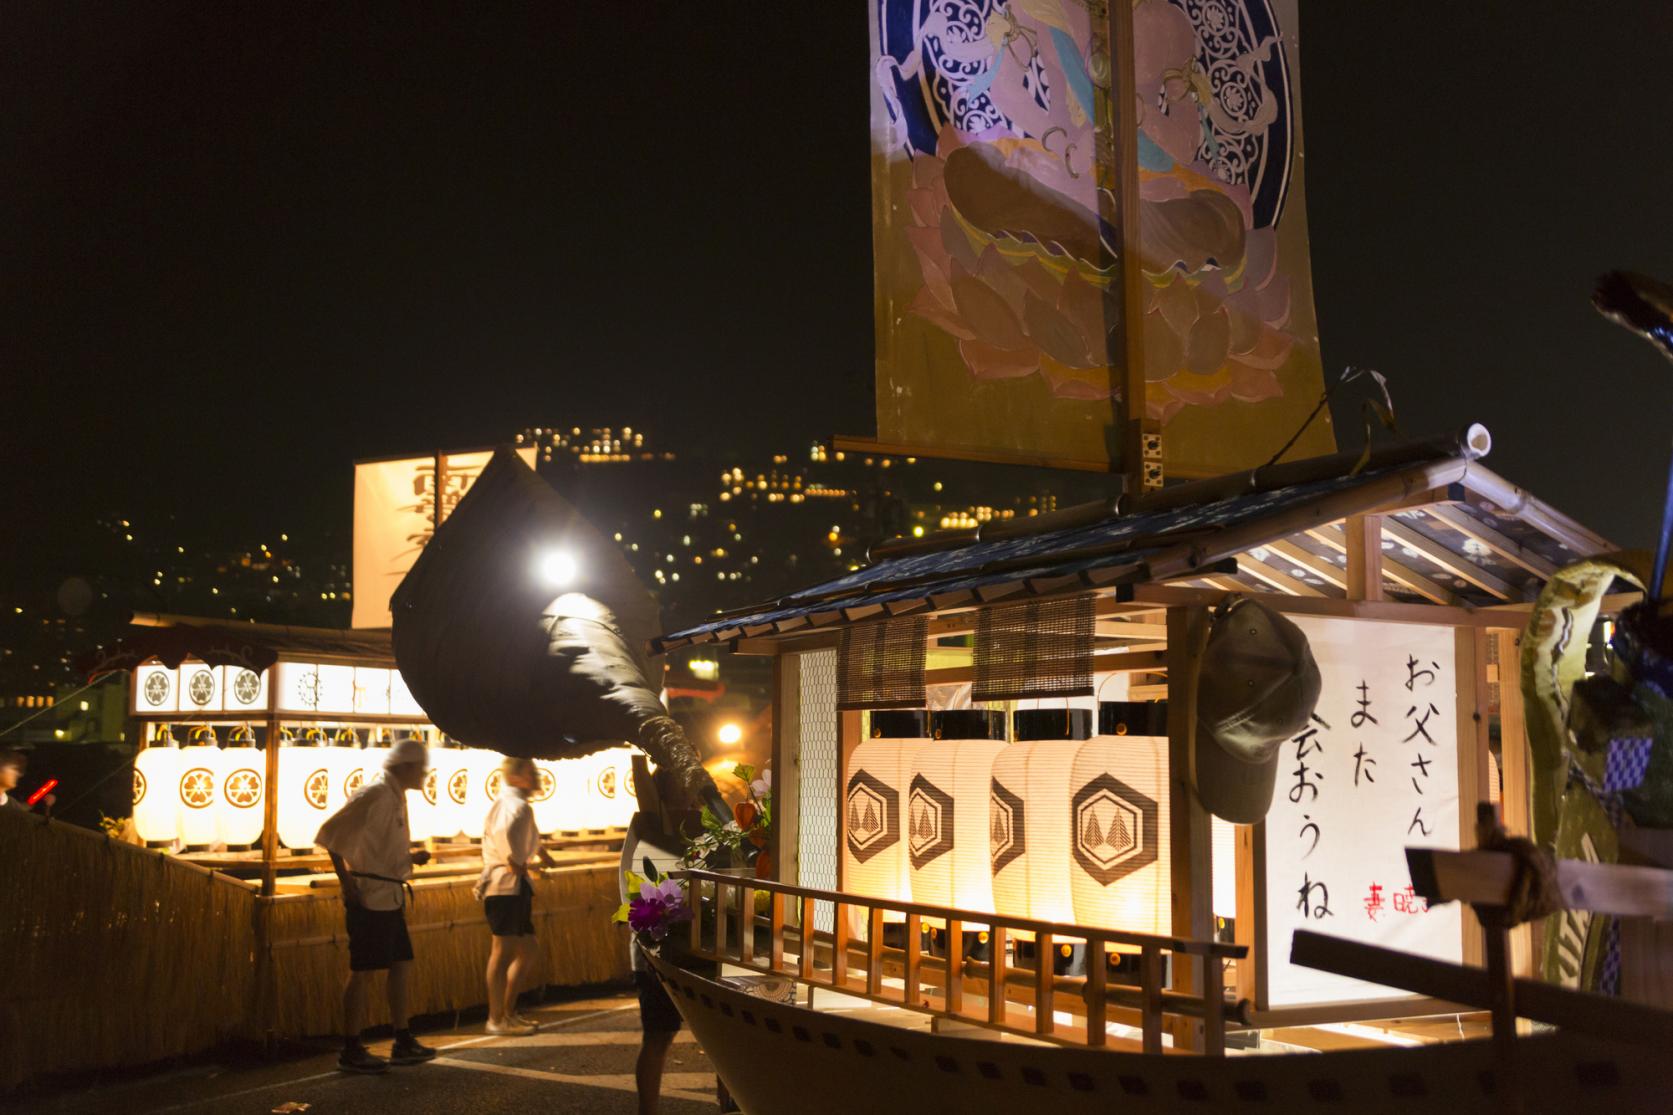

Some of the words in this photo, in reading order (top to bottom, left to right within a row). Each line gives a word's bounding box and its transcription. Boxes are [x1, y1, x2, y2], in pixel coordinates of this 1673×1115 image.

[1349, 679, 1379, 786] また
[1401, 653, 1441, 836] お父さん
